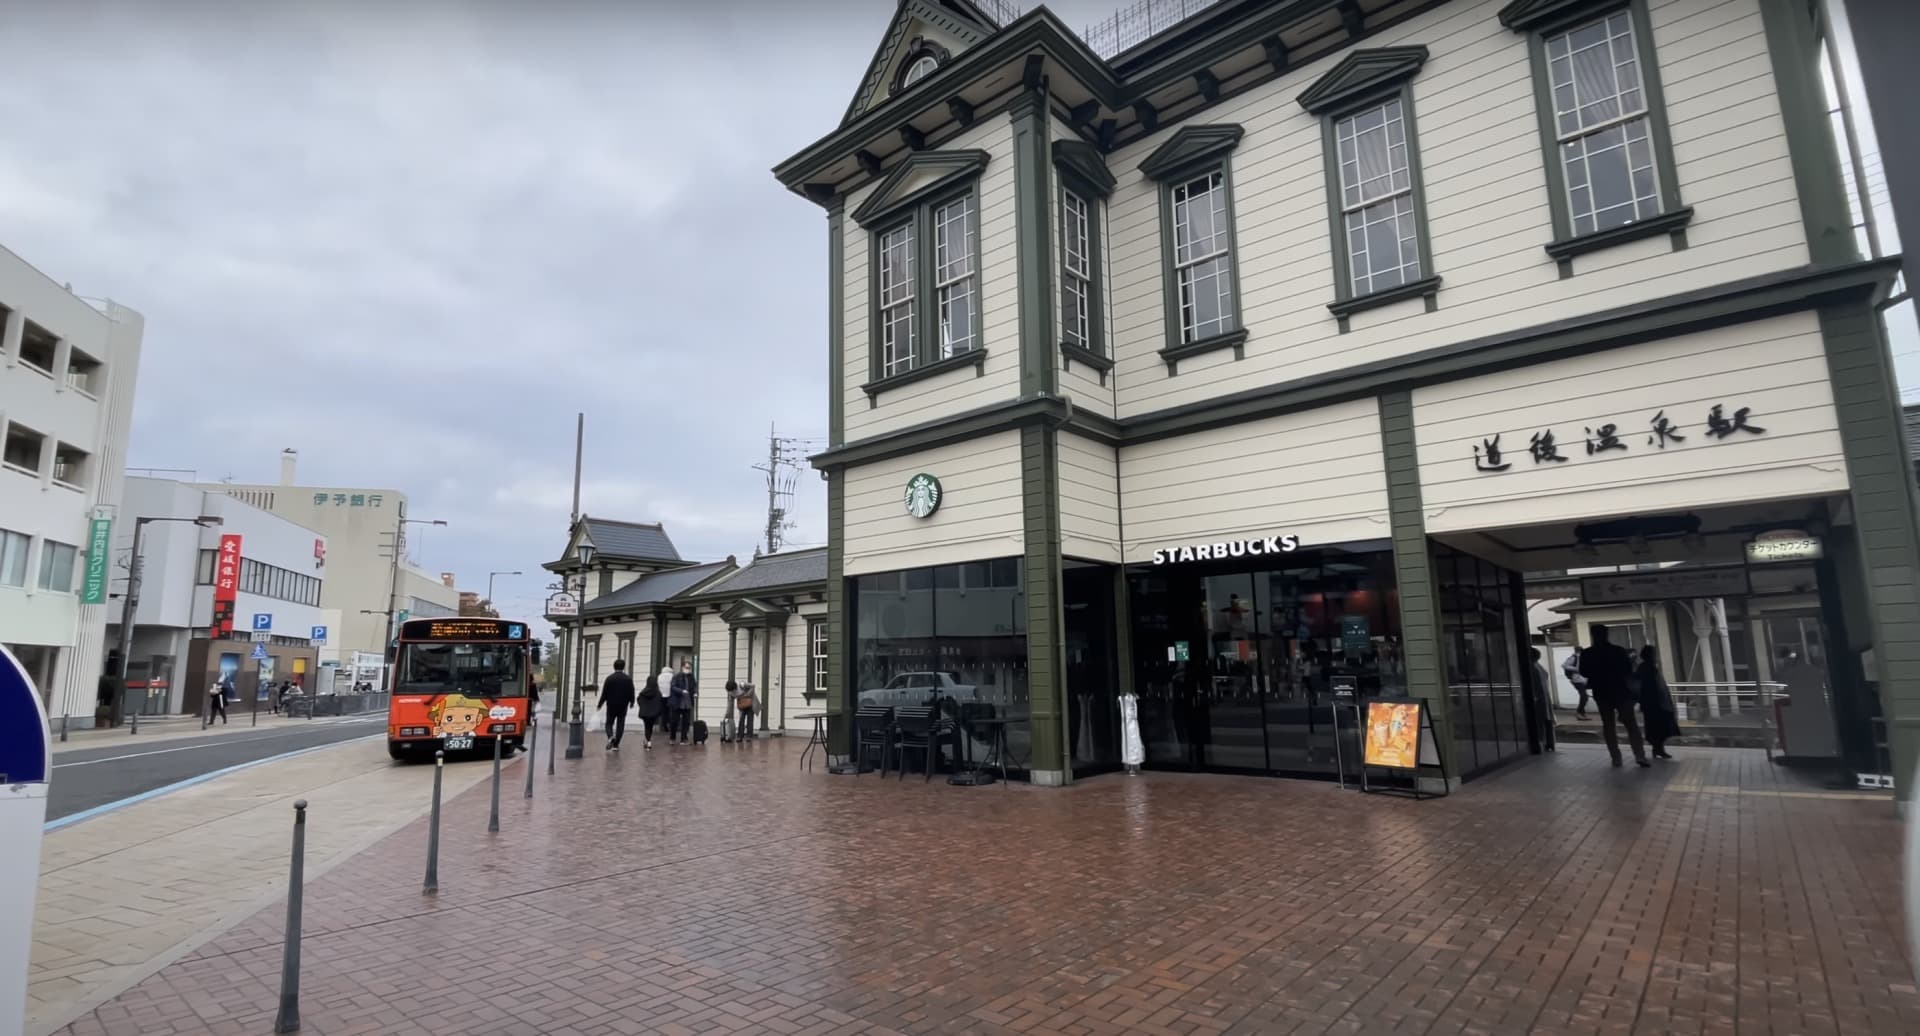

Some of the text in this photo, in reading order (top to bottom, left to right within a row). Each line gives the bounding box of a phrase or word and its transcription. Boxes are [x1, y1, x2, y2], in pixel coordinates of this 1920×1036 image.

[1473, 404, 1766, 472] 道後温泉駅
[313, 493, 383, 507] 伊予銀行
[1153, 534, 1298, 565] STARBUCKS
[1747, 540, 1817, 553] チケットカウンター
[220, 540, 236, 589] 愛媛銀行
[257, 615, 269, 628] P
[314, 627, 324, 638] P
